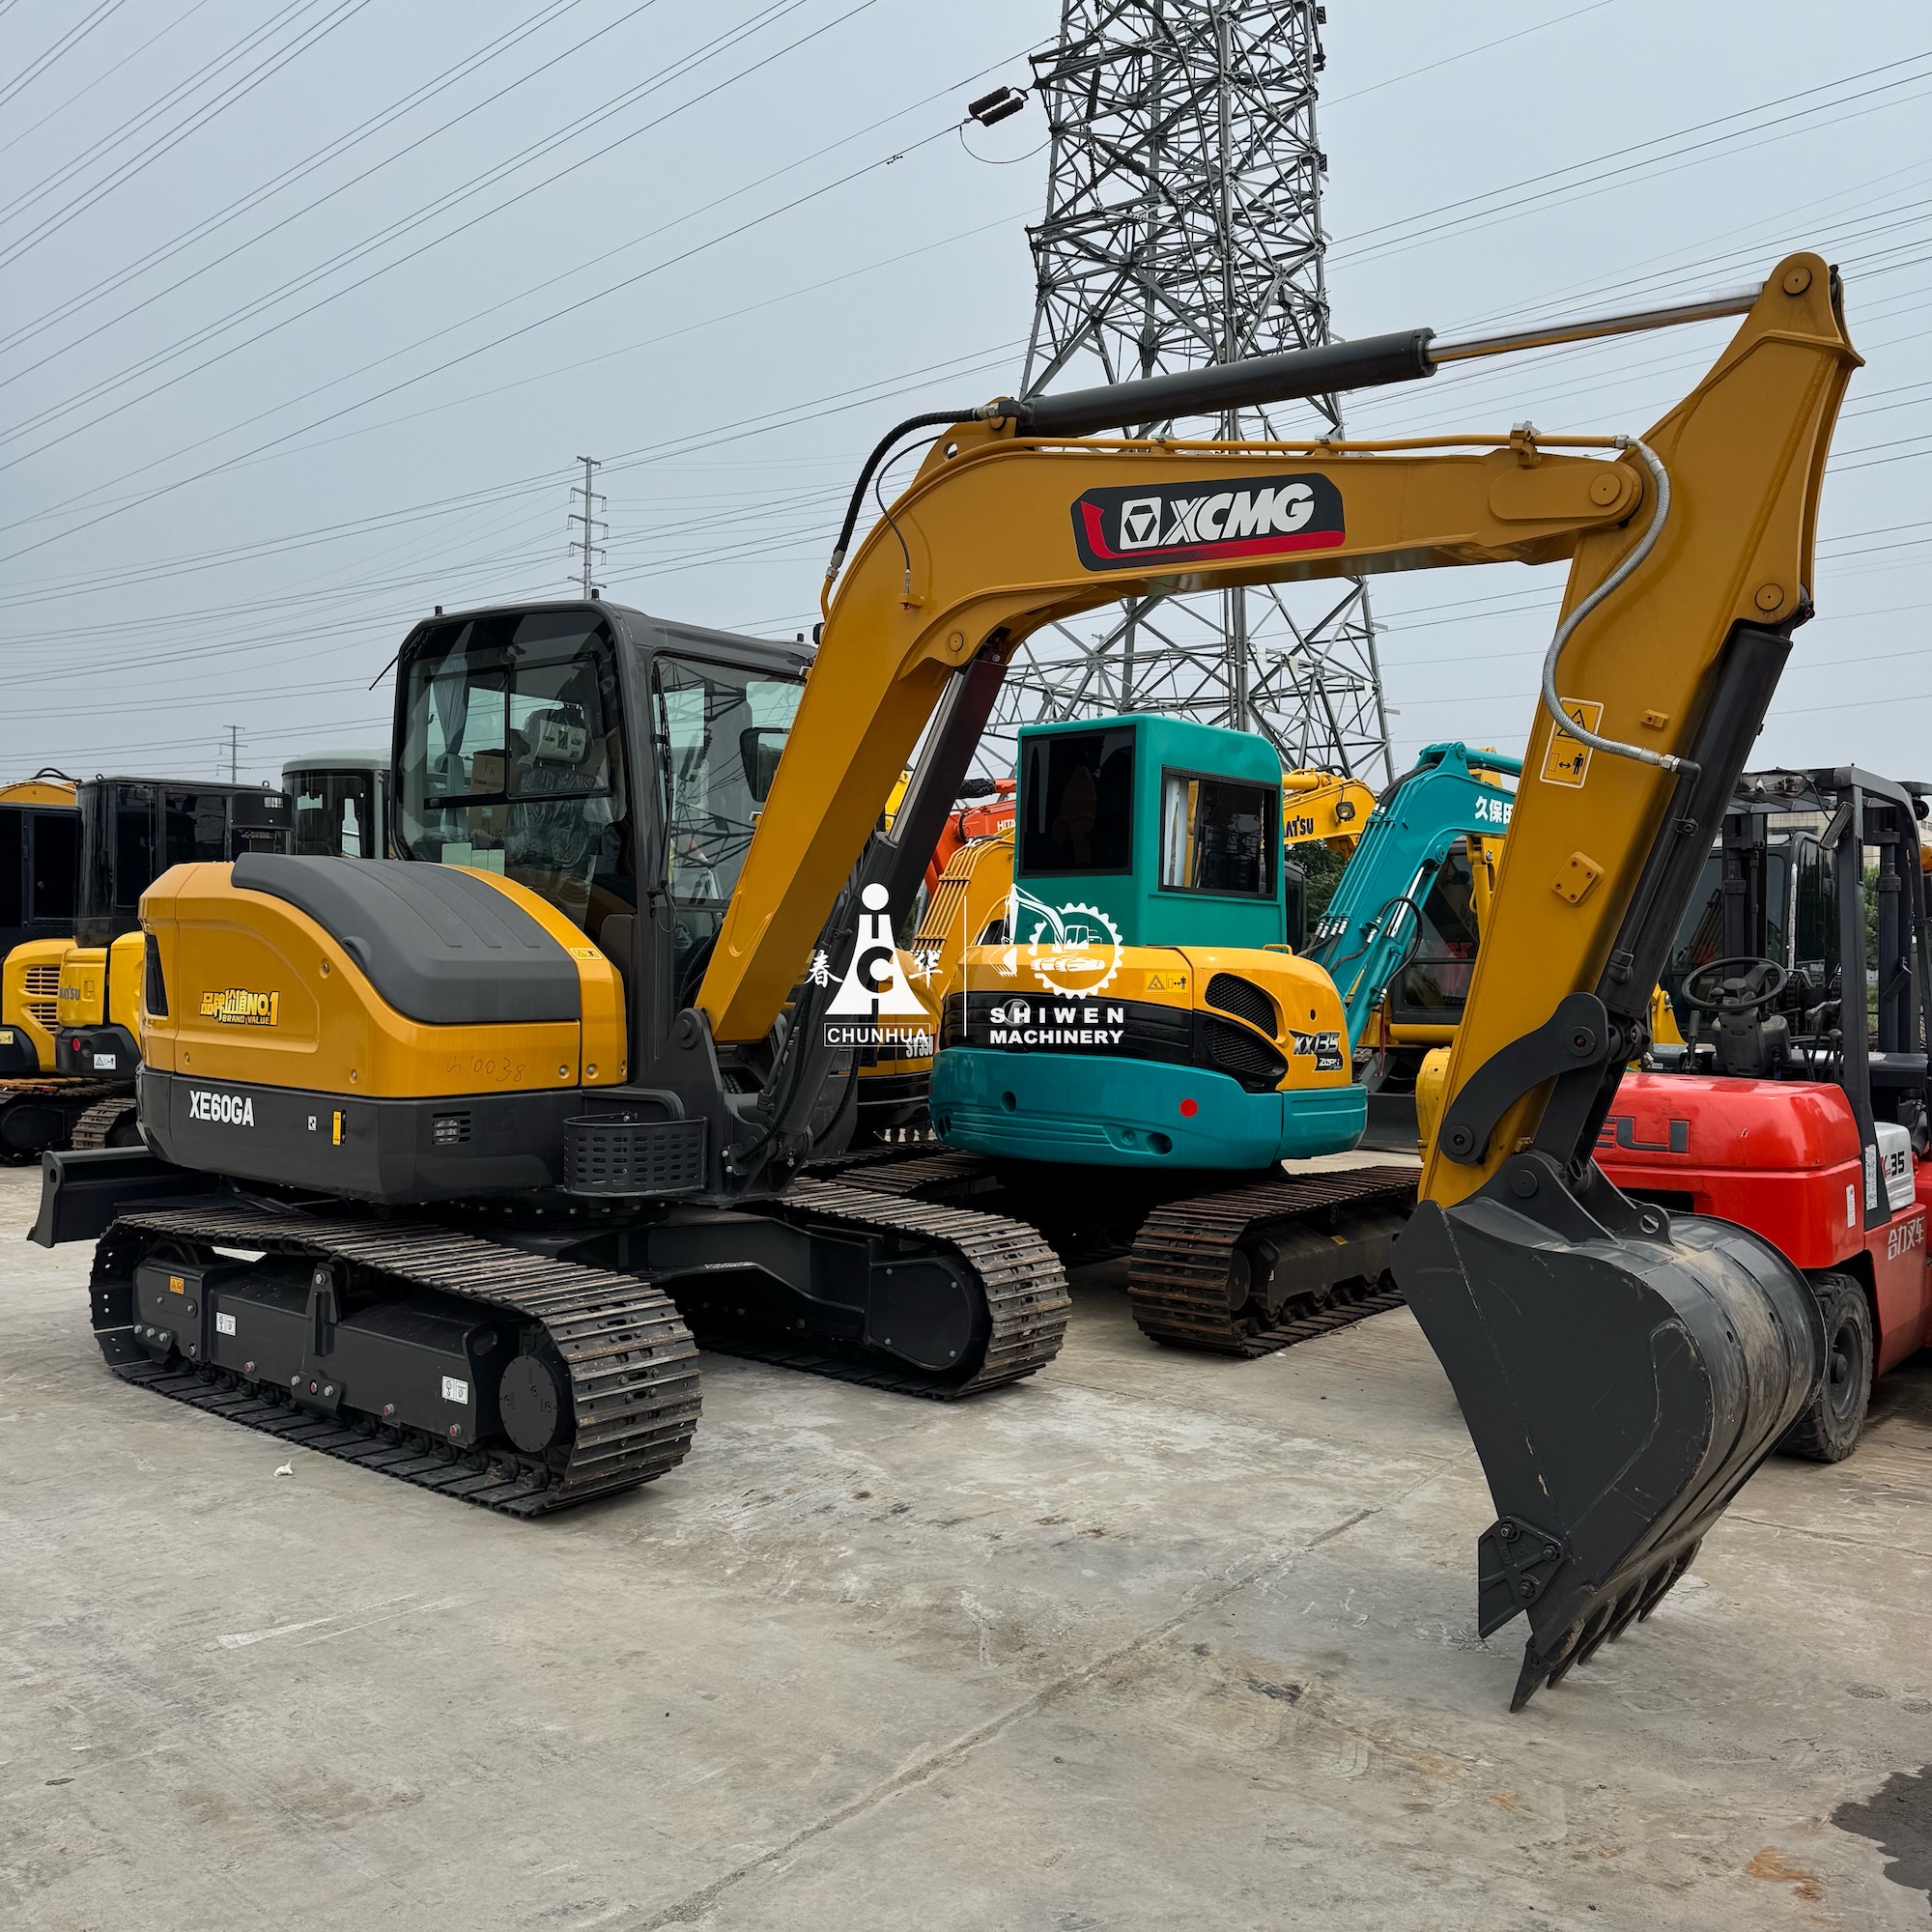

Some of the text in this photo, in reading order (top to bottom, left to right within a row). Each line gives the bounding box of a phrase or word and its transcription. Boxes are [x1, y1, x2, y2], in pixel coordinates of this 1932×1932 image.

[1158, 483, 1315, 546] XCMG
[222, 1014, 270, 1025] BRAND VALUE
[188, 1090, 255, 1127] XE60GA
[1889, 1216, 1925, 1261] 合力叉车
